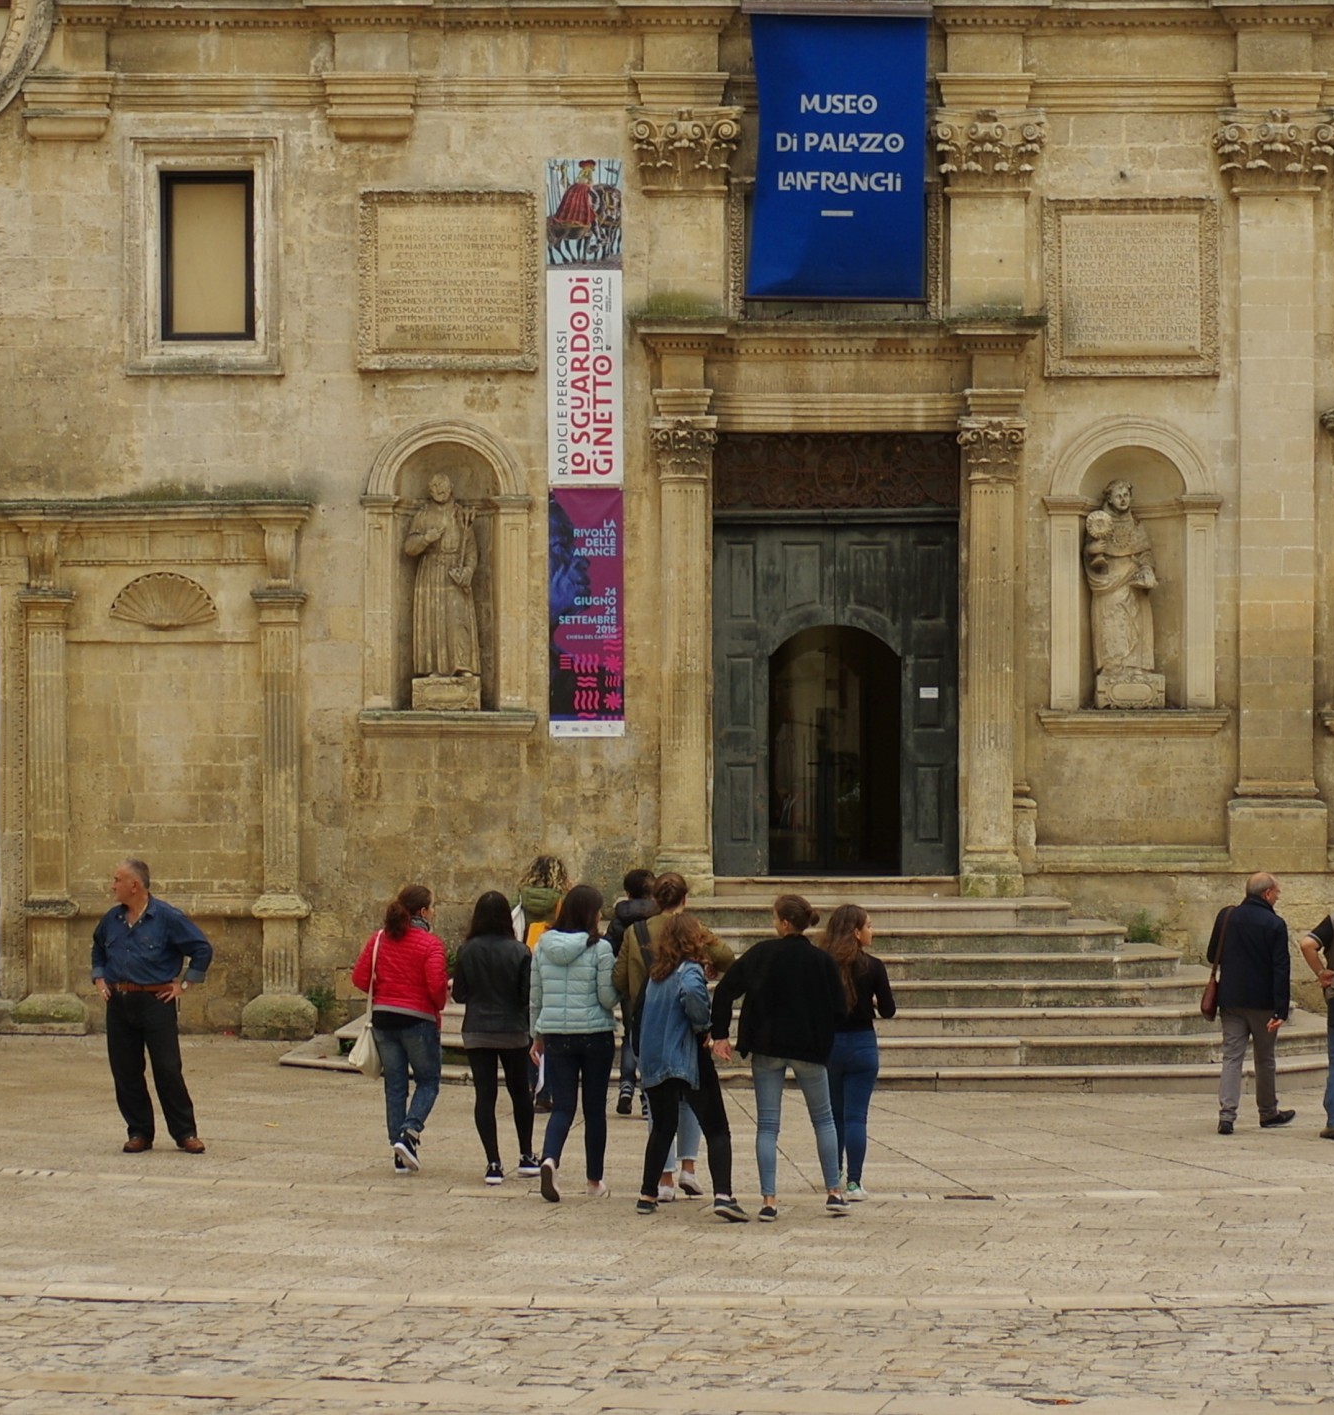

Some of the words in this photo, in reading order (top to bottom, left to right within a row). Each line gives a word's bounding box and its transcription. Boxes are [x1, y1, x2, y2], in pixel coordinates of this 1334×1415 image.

[800, 94, 878, 114] MUSEO
[804, 132, 905, 153] PALAZZO
[593, 276, 604, 353] 1996-2016
[556, 331, 568, 407] PERCORSI
[557, 411, 568, 419] E
[557, 423, 568, 476] RADICI
[603, 519, 616, 528] LA
[573, 528, 616, 538] RIVOLTA
[585, 538, 616, 547] DELLE
[573, 547, 616, 556] ARANCE
[604, 587, 617, 596] 24
[574, 597, 617, 606] GIUGNO
[604, 606, 617, 615] 24
[558, 615, 617, 625] SETTEMBRE
[595, 625, 617, 634] 2016
